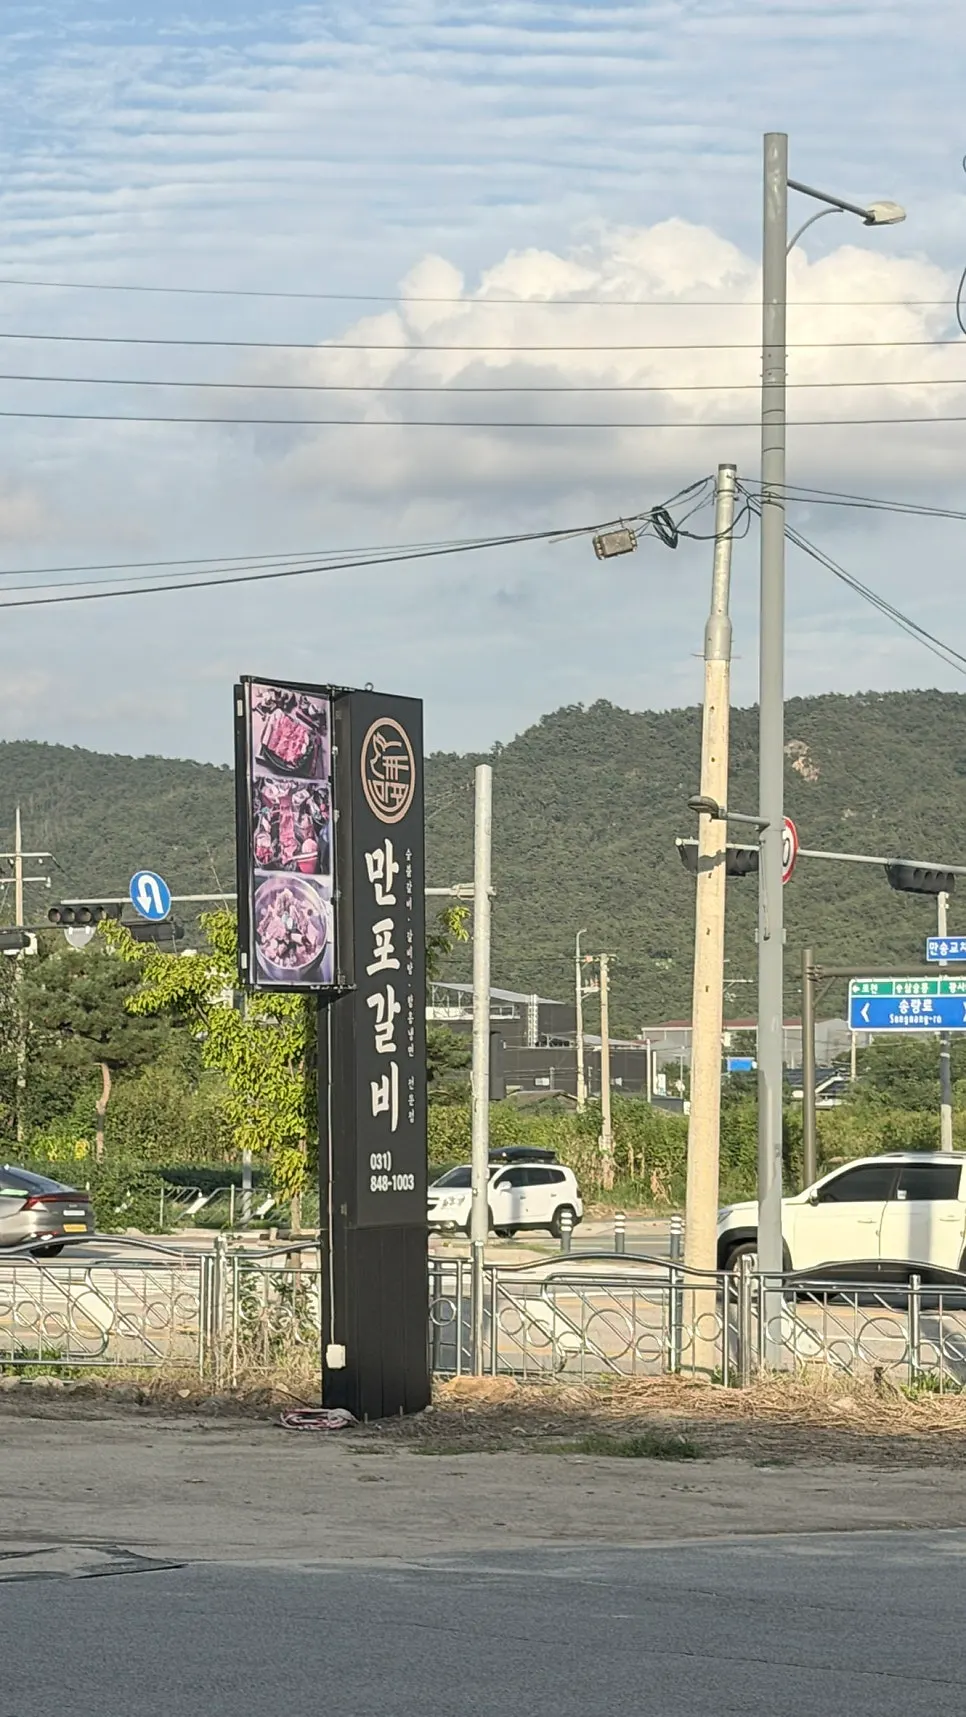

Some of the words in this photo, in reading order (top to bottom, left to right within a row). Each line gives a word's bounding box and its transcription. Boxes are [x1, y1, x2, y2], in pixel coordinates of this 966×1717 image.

[364, 838, 401, 1132] 만포갈비
[407, 1075, 416, 1124] 전문점
[370, 1151, 392, 1171] 031)
[370, 1171, 415, 1193] 848-1003
